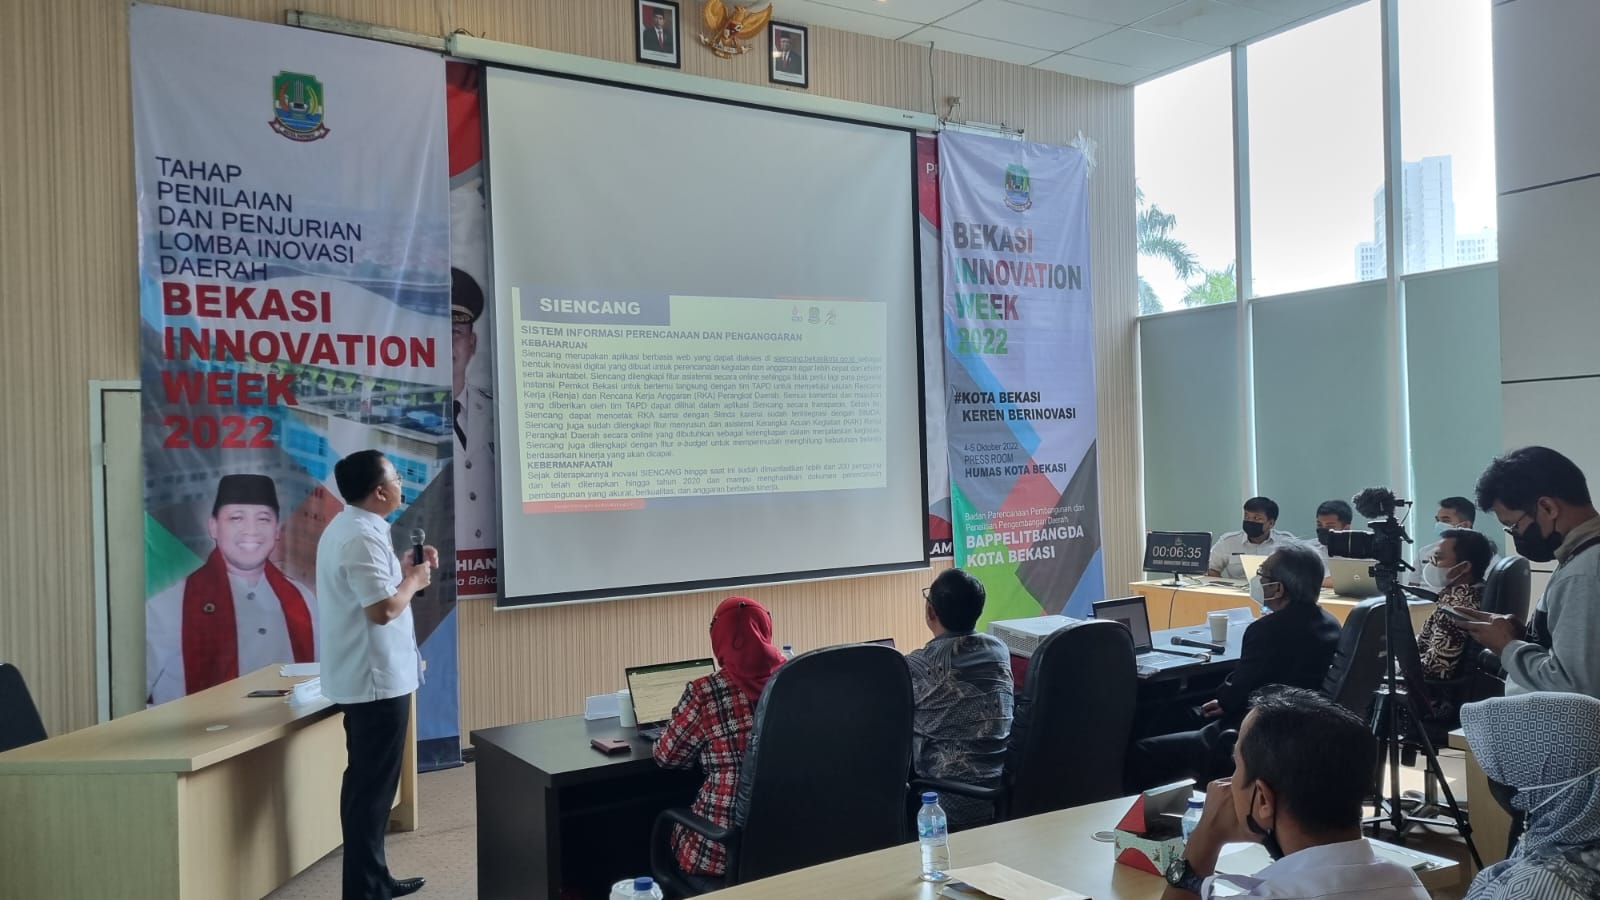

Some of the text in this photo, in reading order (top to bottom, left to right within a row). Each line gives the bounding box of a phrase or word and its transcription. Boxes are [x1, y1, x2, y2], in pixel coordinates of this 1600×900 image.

[156, 157, 241, 183] TAHAP
[157, 181, 293, 212] PENILAIAN
[158, 206, 362, 241] DAN PENJURIAN
[159, 231, 354, 264] LOMBA INOVASI
[953, 222, 1033, 254] BEKASI
[160, 256, 267, 280] DAERAH
[954, 256, 1082, 290] INNOVATION
[162, 282, 331, 323] BEKASI
[539, 298, 641, 315] SIENCANG
[955, 292, 1020, 321] WEEK
[520, 326, 801, 341] SISTEM INFORMASI PERENCANAAN DAN PENGANGGARAN
[521, 339, 587, 349] KEBAHARUAN
[957, 327, 1008, 355] 2022
[164, 326, 436, 368] INNOVATION
[161, 370, 299, 406] WEEK
[954, 391, 1041, 405] #KOTA BEKASI
[962, 407, 1076, 422] KEREN BERINOVASI
[162, 414, 275, 449] 2022
[976, 443, 1001, 451] Oktober
[1003, 442, 1018, 450] 2022
[527, 461, 612, 469] KEBERMANFAATAN
[964, 454, 1014, 465] PRESS ROOM
[965, 463, 1067, 478] HUMAS KOTA BEKASI
[966, 525, 1084, 549] BAPPELITBANGDA
[967, 546, 1056, 567] KOTA BEKASI
[1152, 546, 1201, 558] 00:06:35
